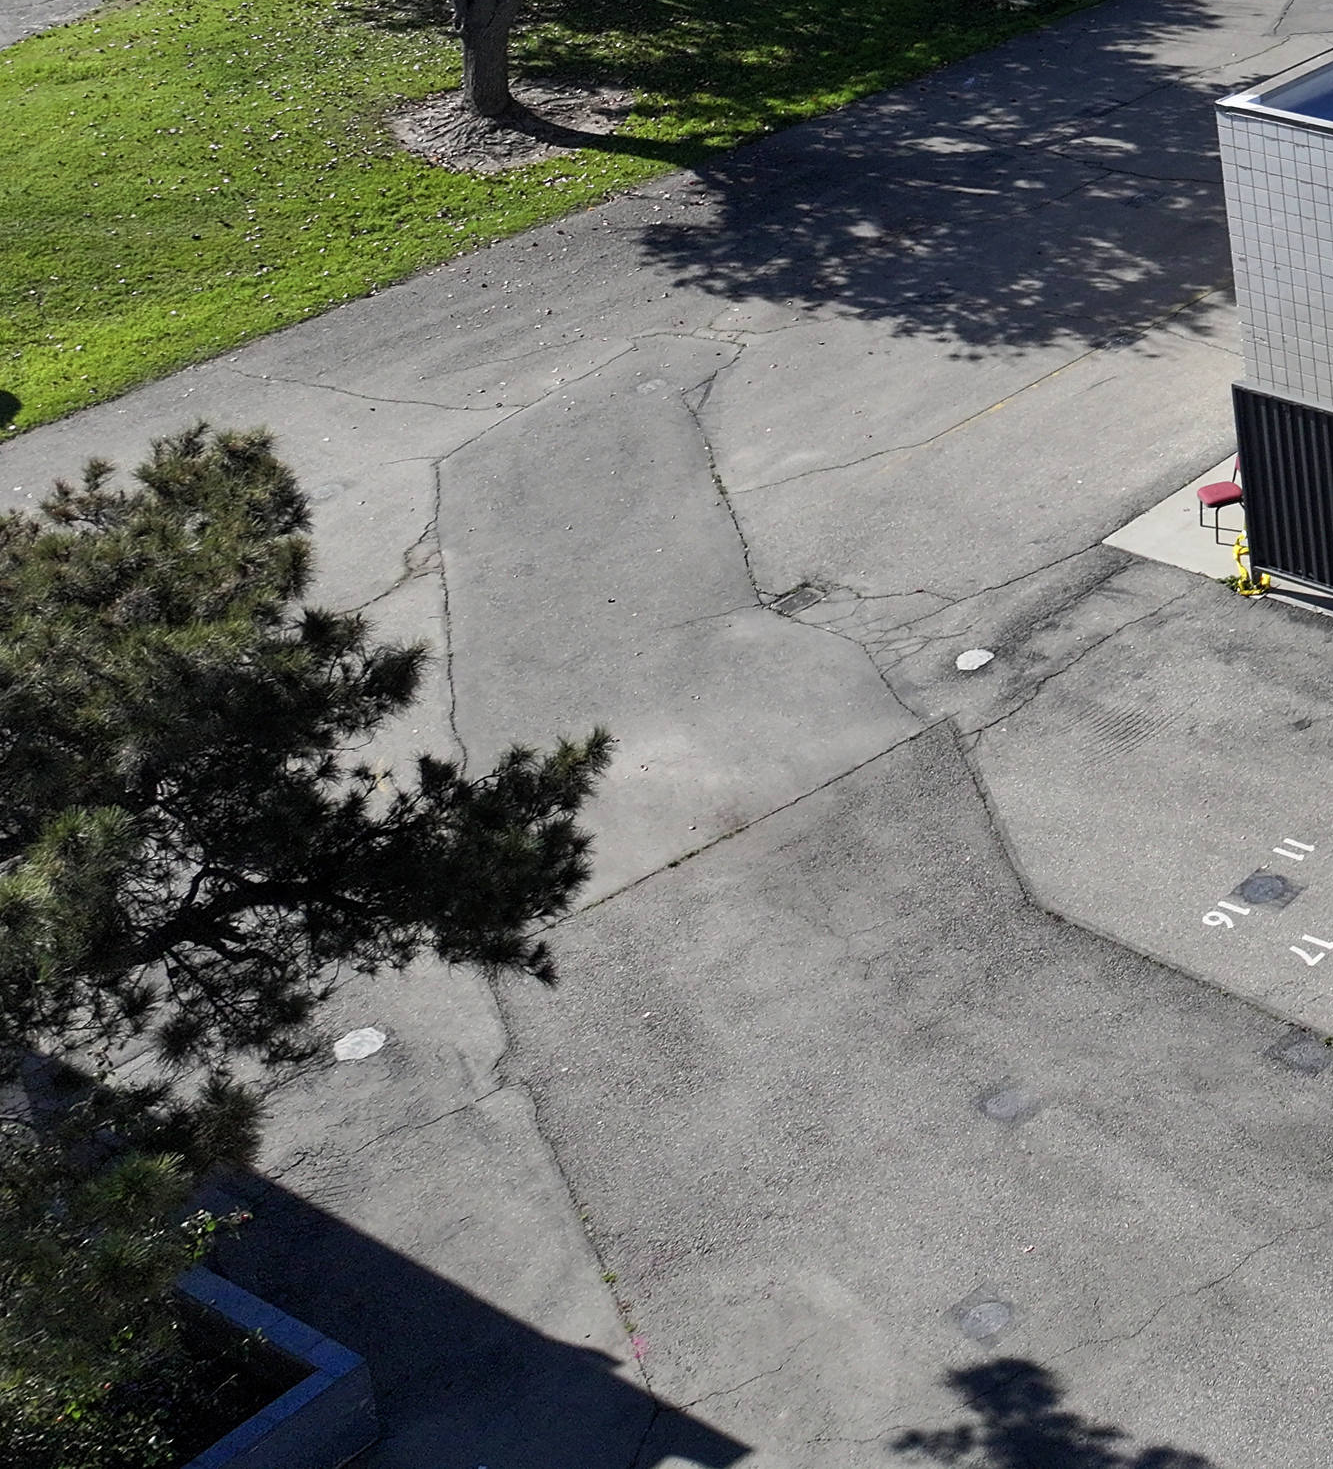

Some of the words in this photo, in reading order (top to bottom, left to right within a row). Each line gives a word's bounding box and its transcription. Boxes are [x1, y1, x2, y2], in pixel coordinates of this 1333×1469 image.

[1273, 838, 1314, 861] 11
[1202, 901, 1249, 928] 16
[1289, 934, 1333, 966] 17
